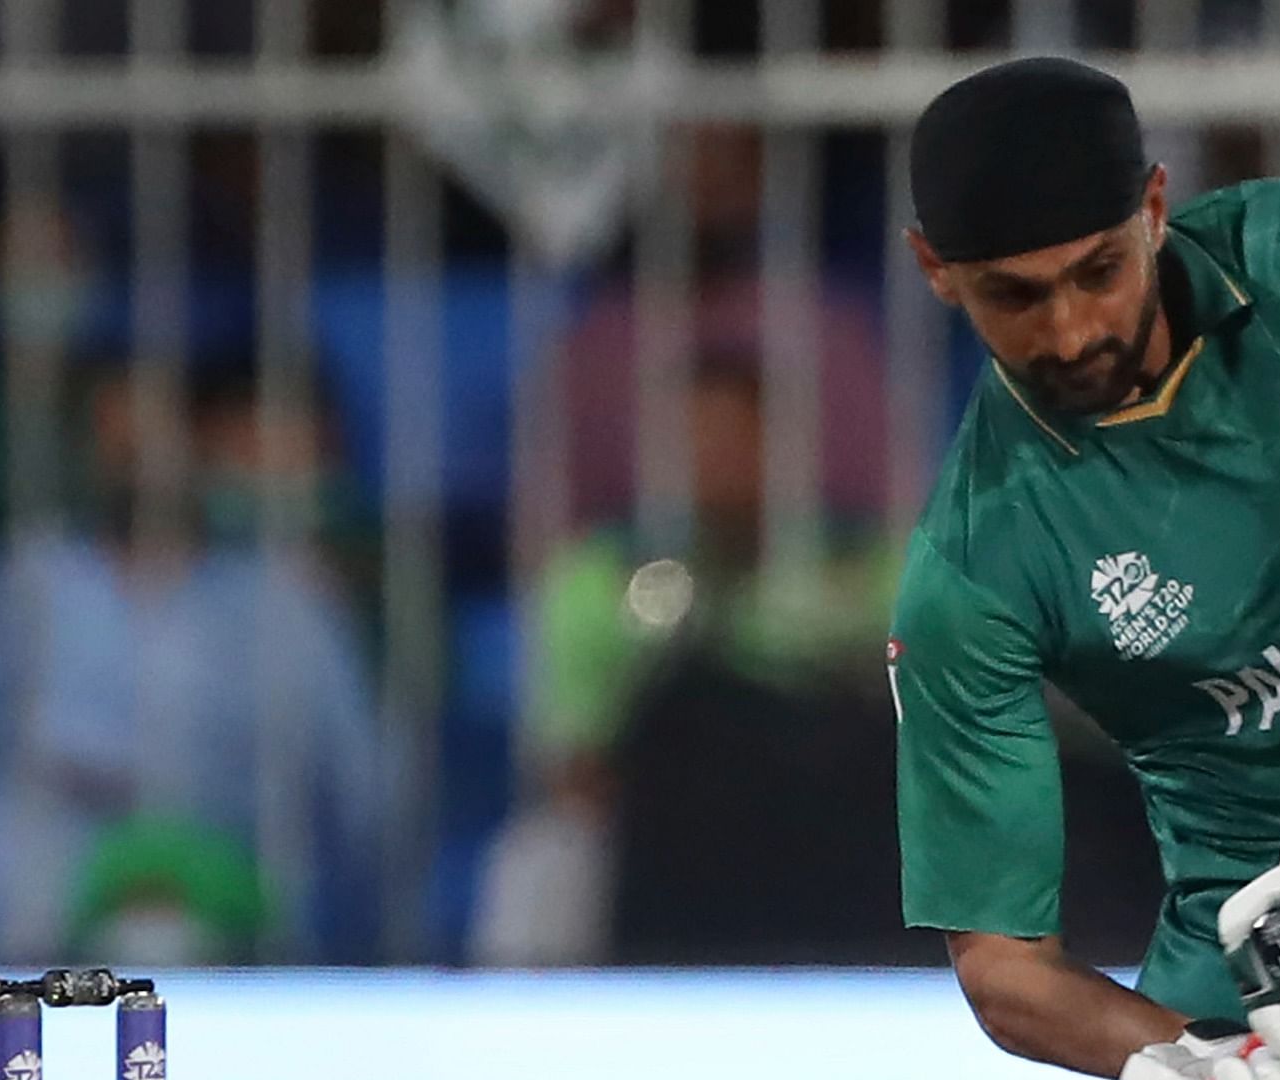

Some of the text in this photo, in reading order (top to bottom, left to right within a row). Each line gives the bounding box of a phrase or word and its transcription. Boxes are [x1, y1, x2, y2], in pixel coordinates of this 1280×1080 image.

[1114, 579, 1180, 651] MEN'S T20
[1165, 584, 1194, 618] CUP
